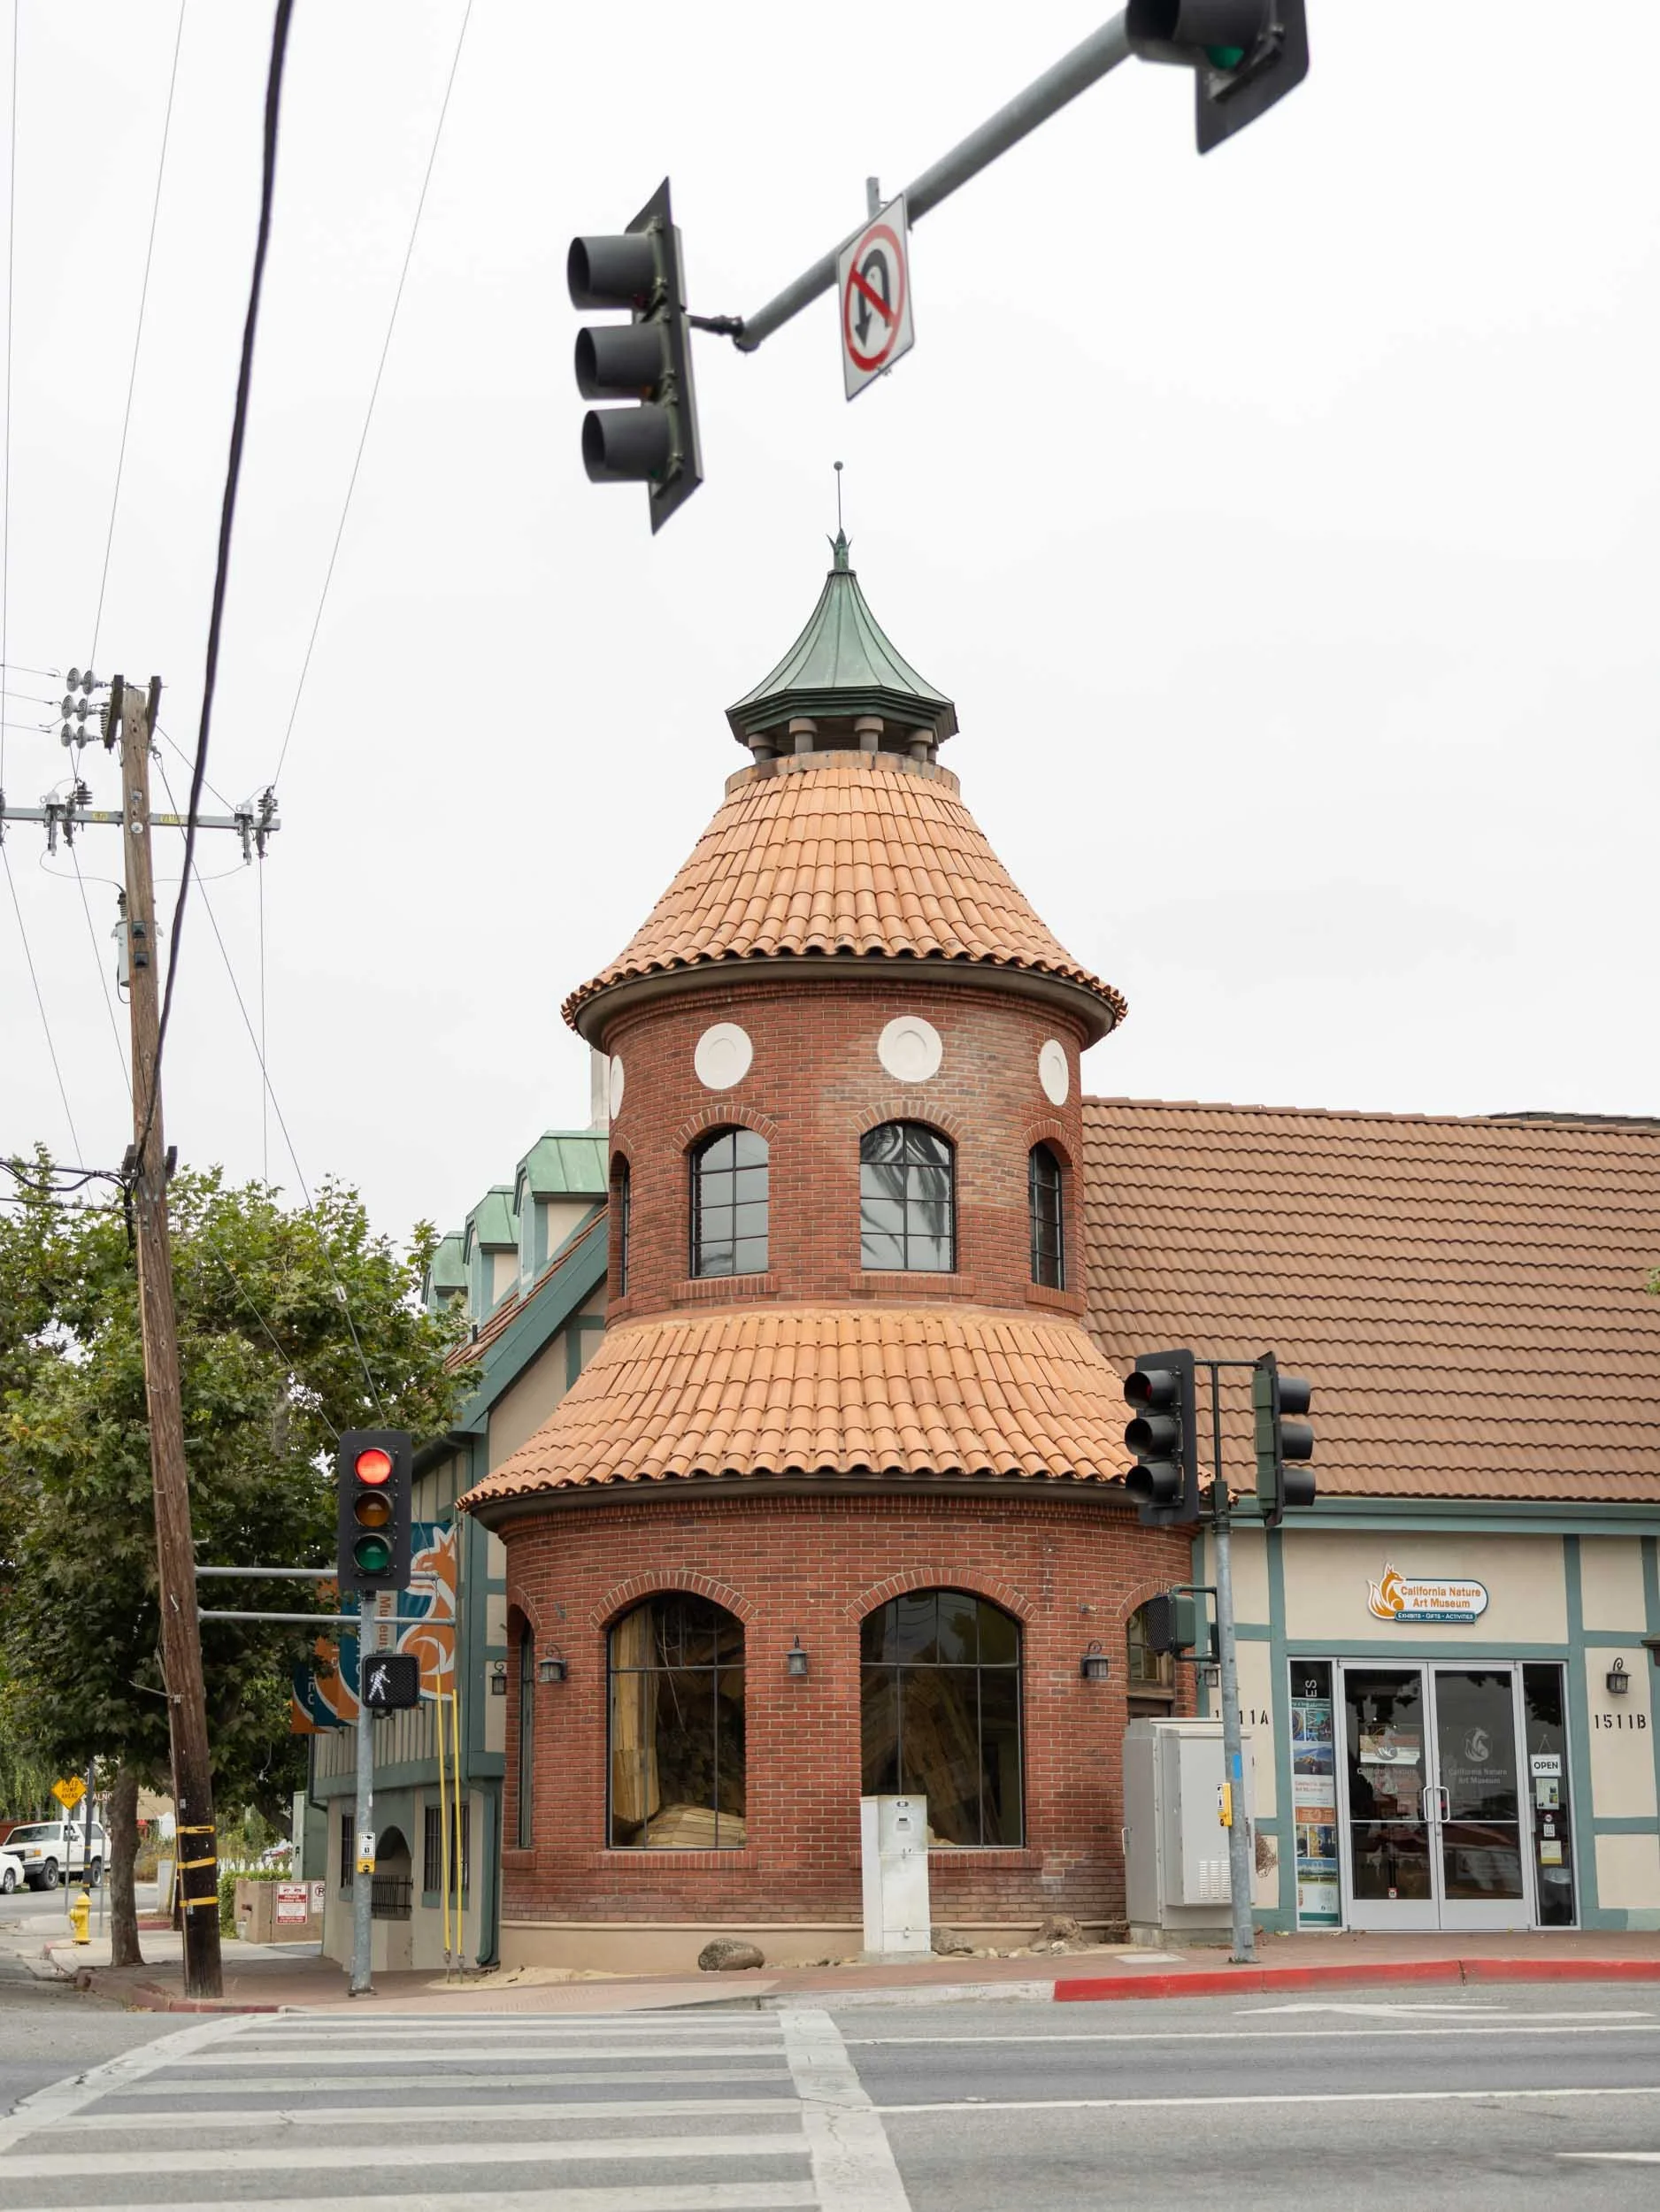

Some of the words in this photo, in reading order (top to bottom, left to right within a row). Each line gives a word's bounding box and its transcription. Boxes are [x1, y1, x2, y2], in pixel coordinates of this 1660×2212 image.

[1401, 1586, 1446, 1596] California
[1449, 1586, 1481, 1597] Nature
[1412, 1598, 1427, 1608] Art
[1430, 1598, 1471, 1608] Museum
[379, 1595, 391, 1651] Mueu
[1595, 1714, 1647, 1729] 1511B
